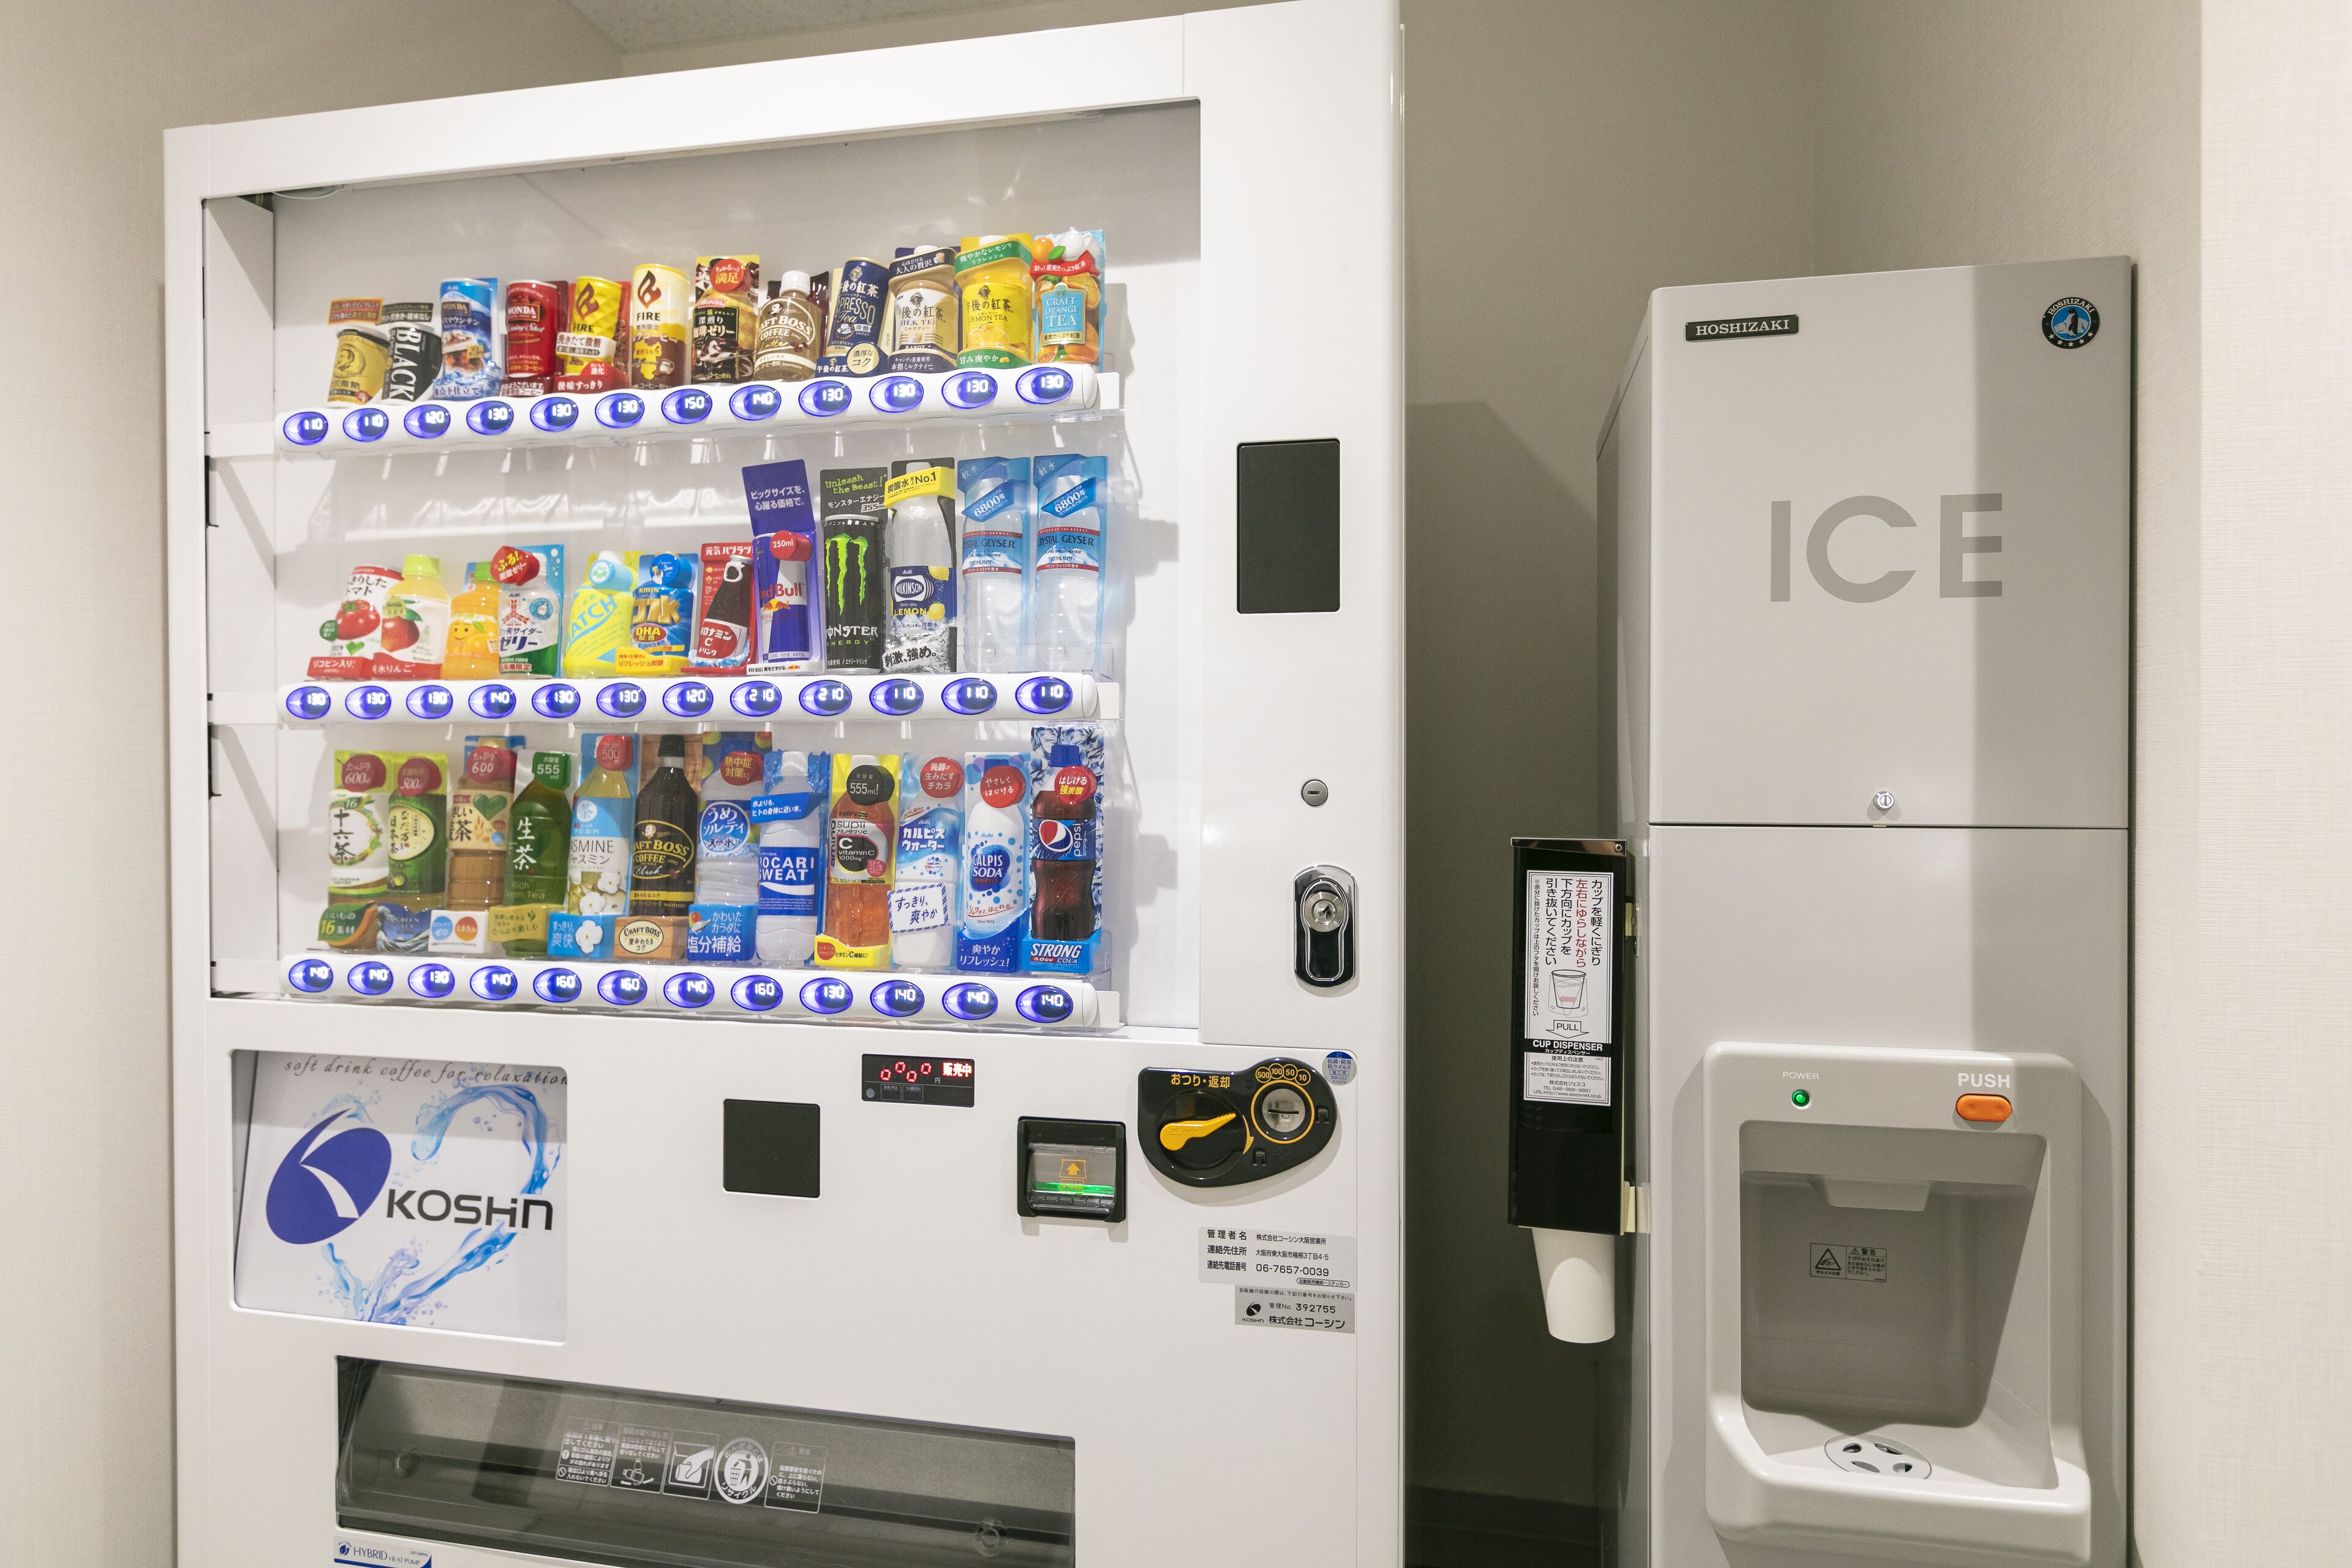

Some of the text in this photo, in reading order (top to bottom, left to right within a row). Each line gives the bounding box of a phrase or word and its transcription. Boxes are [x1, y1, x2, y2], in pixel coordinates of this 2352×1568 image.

[715, 273, 739, 284] 満足
[1047, 297, 1076, 306] CRAFT
[2048, 298, 2095, 315] HOSHIZAKI
[637, 312, 661, 321] FIRE
[1046, 306, 1077, 315] ORANGE
[779, 316, 812, 335] BOSS
[1047, 315, 1077, 327] TEA
[1695, 318, 1790, 336] HOSHIZAKI
[573, 323, 594, 333] FIRE
[760, 328, 789, 340] COFFEE
[390, 329, 423, 401] BLACK
[852, 358, 870, 367] コク
[959, 355, 999, 364] 甘み爽やか
[816, 364, 849, 373] 午後の紅茶
[892, 363, 933, 371] 本格ミルクティー
[967, 380, 988, 393] 130
[1041, 375, 1064, 388] 130
[823, 388, 843, 401] 130
[894, 383, 916, 397] 130
[685, 396, 704, 409] 150
[753, 392, 774, 405] 140
[1038, 462, 1057, 477] 軟水
[825, 474, 864, 489] Unleash
[888, 478, 910, 493] 炭酸水
[833, 486, 850, 494] the
[974, 492, 1006, 517] 6800年
[1055, 489, 1086, 513] 6800年
[773, 539, 794, 548] 250ml
[981, 539, 1015, 549] GEYSER
[1061, 535, 1093, 546] GEYSER
[1770, 492, 2003, 603] ICE
[775, 582, 802, 597] Bull
[896, 582, 922, 595] WILKINSON
[636, 627, 661, 636] DHA
[884, 647, 937, 667] 刺激、強め。
[491, 692, 509, 703] 140
[555, 690, 574, 703] 130
[620, 690, 638, 702] 130
[687, 690, 706, 702] 120
[749, 688, 774, 701] 210
[818, 687, 843, 701] 210
[894, 687, 915, 699] 110
[967, 686, 988, 699] 110
[1042, 685, 1063, 698] 110
[429, 693, 447, 704] 130
[602, 749, 620, 760] 500
[472, 763, 494, 773] 600
[725, 756, 752, 769] 熱中症
[930, 763, 950, 771] 発酵が
[537, 764, 560, 774] 555
[985, 776, 1011, 787] やさしく
[1059, 776, 1087, 785] はじける
[985, 786, 1014, 796] はじける
[1060, 785, 1084, 795] 強炭酸
[708, 807, 737, 824] うめ
[703, 821, 744, 836] ソルティ
[837, 821, 865, 831] supli
[333, 809, 356, 865] 十六茶
[903, 827, 946, 839] カルピス
[513, 817, 537, 870] 生茶
[654, 839, 690, 856] BOSS
[707, 839, 736, 848] 天然水
[839, 838, 853, 850] C
[902, 840, 944, 851] ウォーター
[636, 854, 665, 863] COFFEE
[973, 854, 1003, 866] CALPIS
[635, 865, 663, 875] Black
[973, 867, 1003, 878] SODA
[895, 895, 928, 911] すっきり、
[712, 911, 742, 922] かわいた
[910, 908, 937, 925] 爽やか
[1545, 878, 1558, 965] 引き抜いてください
[1561, 878, 1573, 956] 下方向にカップを
[711, 922, 741, 933] カラダに
[1575, 878, 1588, 968] 左右にゆらしながら
[1591, 880, 1603, 966] カップを軽くにぎり
[624, 927, 662, 937] CRAFT BOSS
[552, 934, 573, 948] 爽快
[688, 935, 741, 954] 塩分補給
[972, 944, 1001, 955] 爽やか
[1030, 943, 1082, 958] STRONG
[960, 955, 1009, 968] リフレッシュ!
[369, 970, 388, 980] 140
[431, 971, 449, 983] 130
[492, 974, 511, 985] 140
[556, 976, 575, 987] 160
[620, 978, 639, 990] 160
[687, 980, 706, 993] 140
[755, 983, 774, 995] 160
[824, 986, 844, 998] 130
[895, 989, 916, 1001] 140
[968, 991, 989, 1004] 140
[1042, 994, 1063, 1006] 140
[1556, 1023, 1579, 1031] PULL
[1532, 1039, 1603, 1051] CUP DISPENSER
[285, 1055, 318, 1076] soft
[324, 1056, 374, 1075] drink
[381, 1060, 431, 1082] coffee
[432, 1063, 466, 1084] for
[943, 1062, 972, 1078] 販売中
[1782, 1071, 1819, 1080] POWER
[1171, 1073, 1231, 1089] おつり・返却
[1958, 1072, 2010, 1088] PUSH
[1207, 1229, 1247, 1240] 管理者名
[1256, 1234, 1326, 1245] 株式会社コーシン大阪営業所
[1207, 1245, 1247, 1256] 連絡先住所
[1207, 1260, 1246, 1272] 連絡先電話番号
[1256, 1264, 1329, 1276] 06-7657-0039
[1296, 1303, 1336, 1314] 392755
[721, 1481, 756, 1499] リサイクル
[353, 1546, 388, 1561] HYBRID
